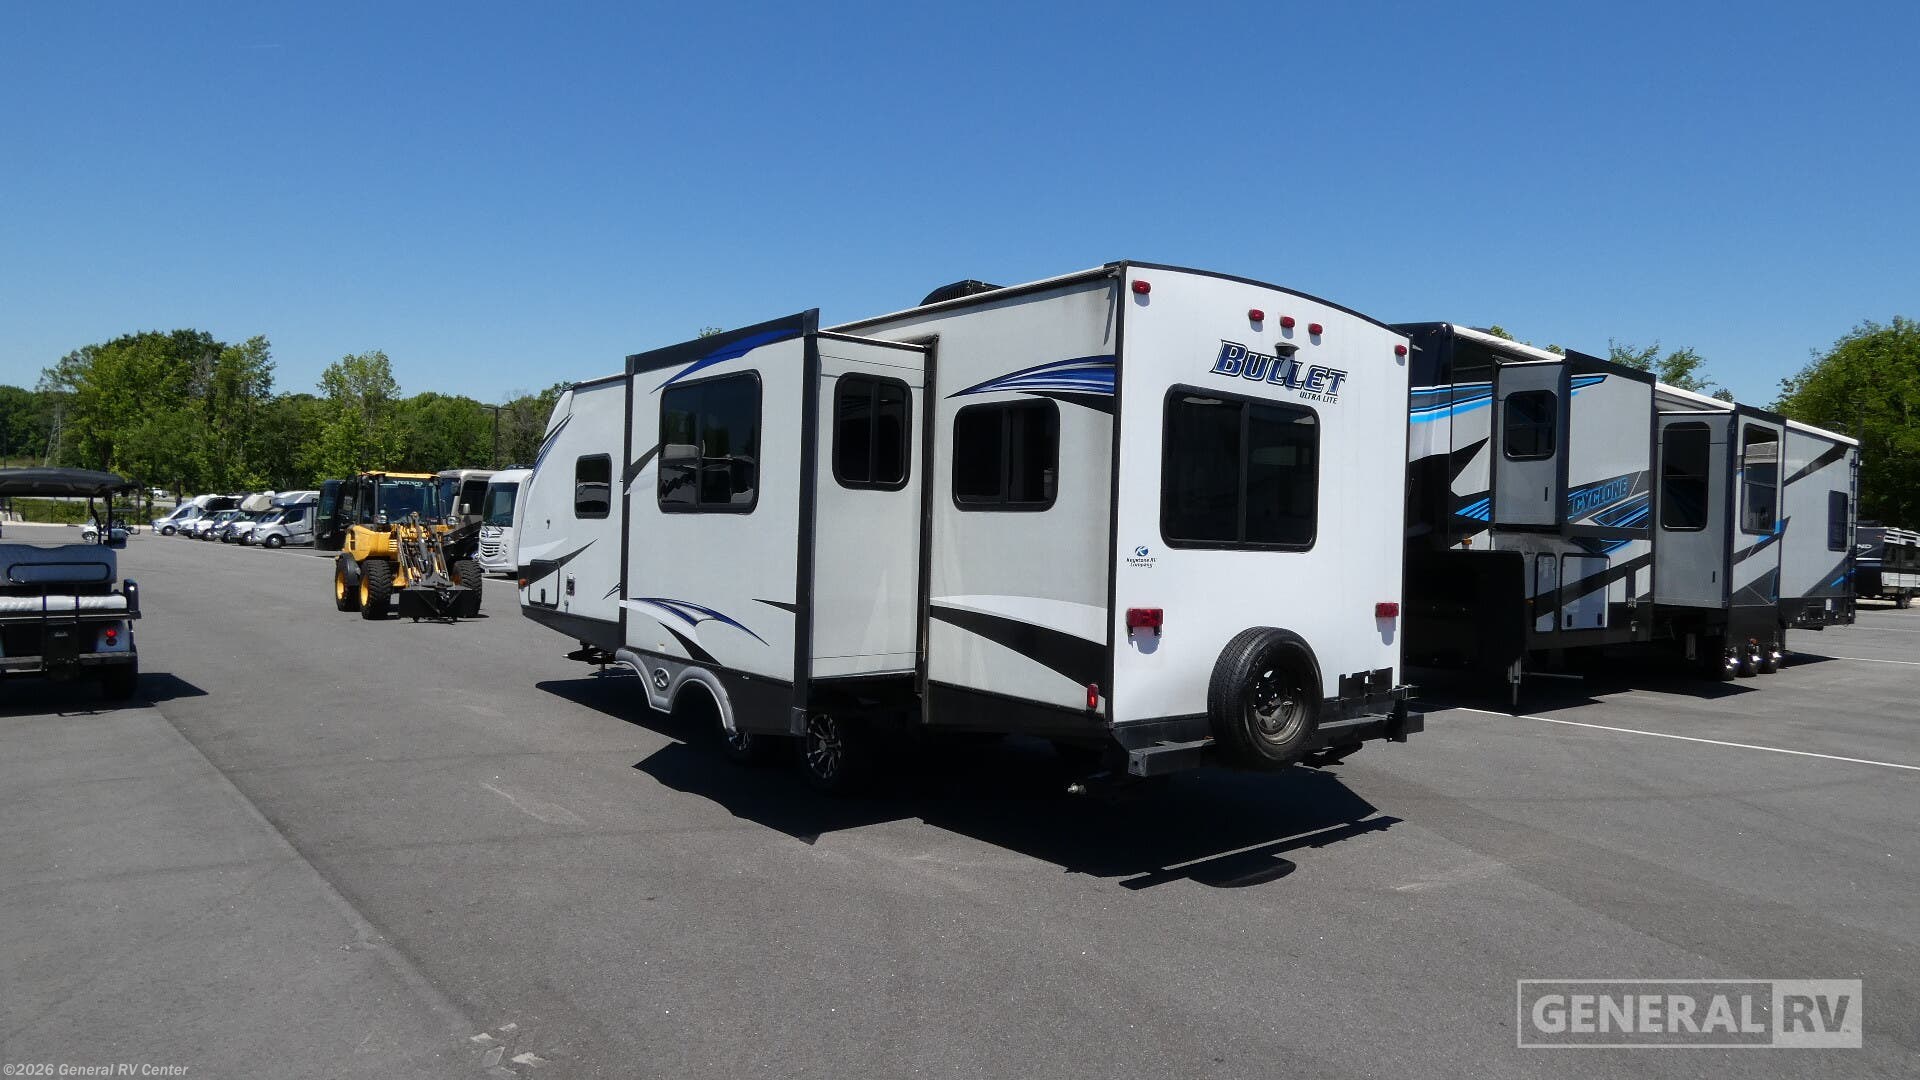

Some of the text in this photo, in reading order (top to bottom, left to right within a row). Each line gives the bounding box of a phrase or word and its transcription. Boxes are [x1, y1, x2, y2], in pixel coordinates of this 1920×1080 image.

[1209, 339, 1348, 396] BULLET
[1299, 391, 1338, 405] ULTRA LITE
[1572, 477, 1629, 513] CYCLONE
